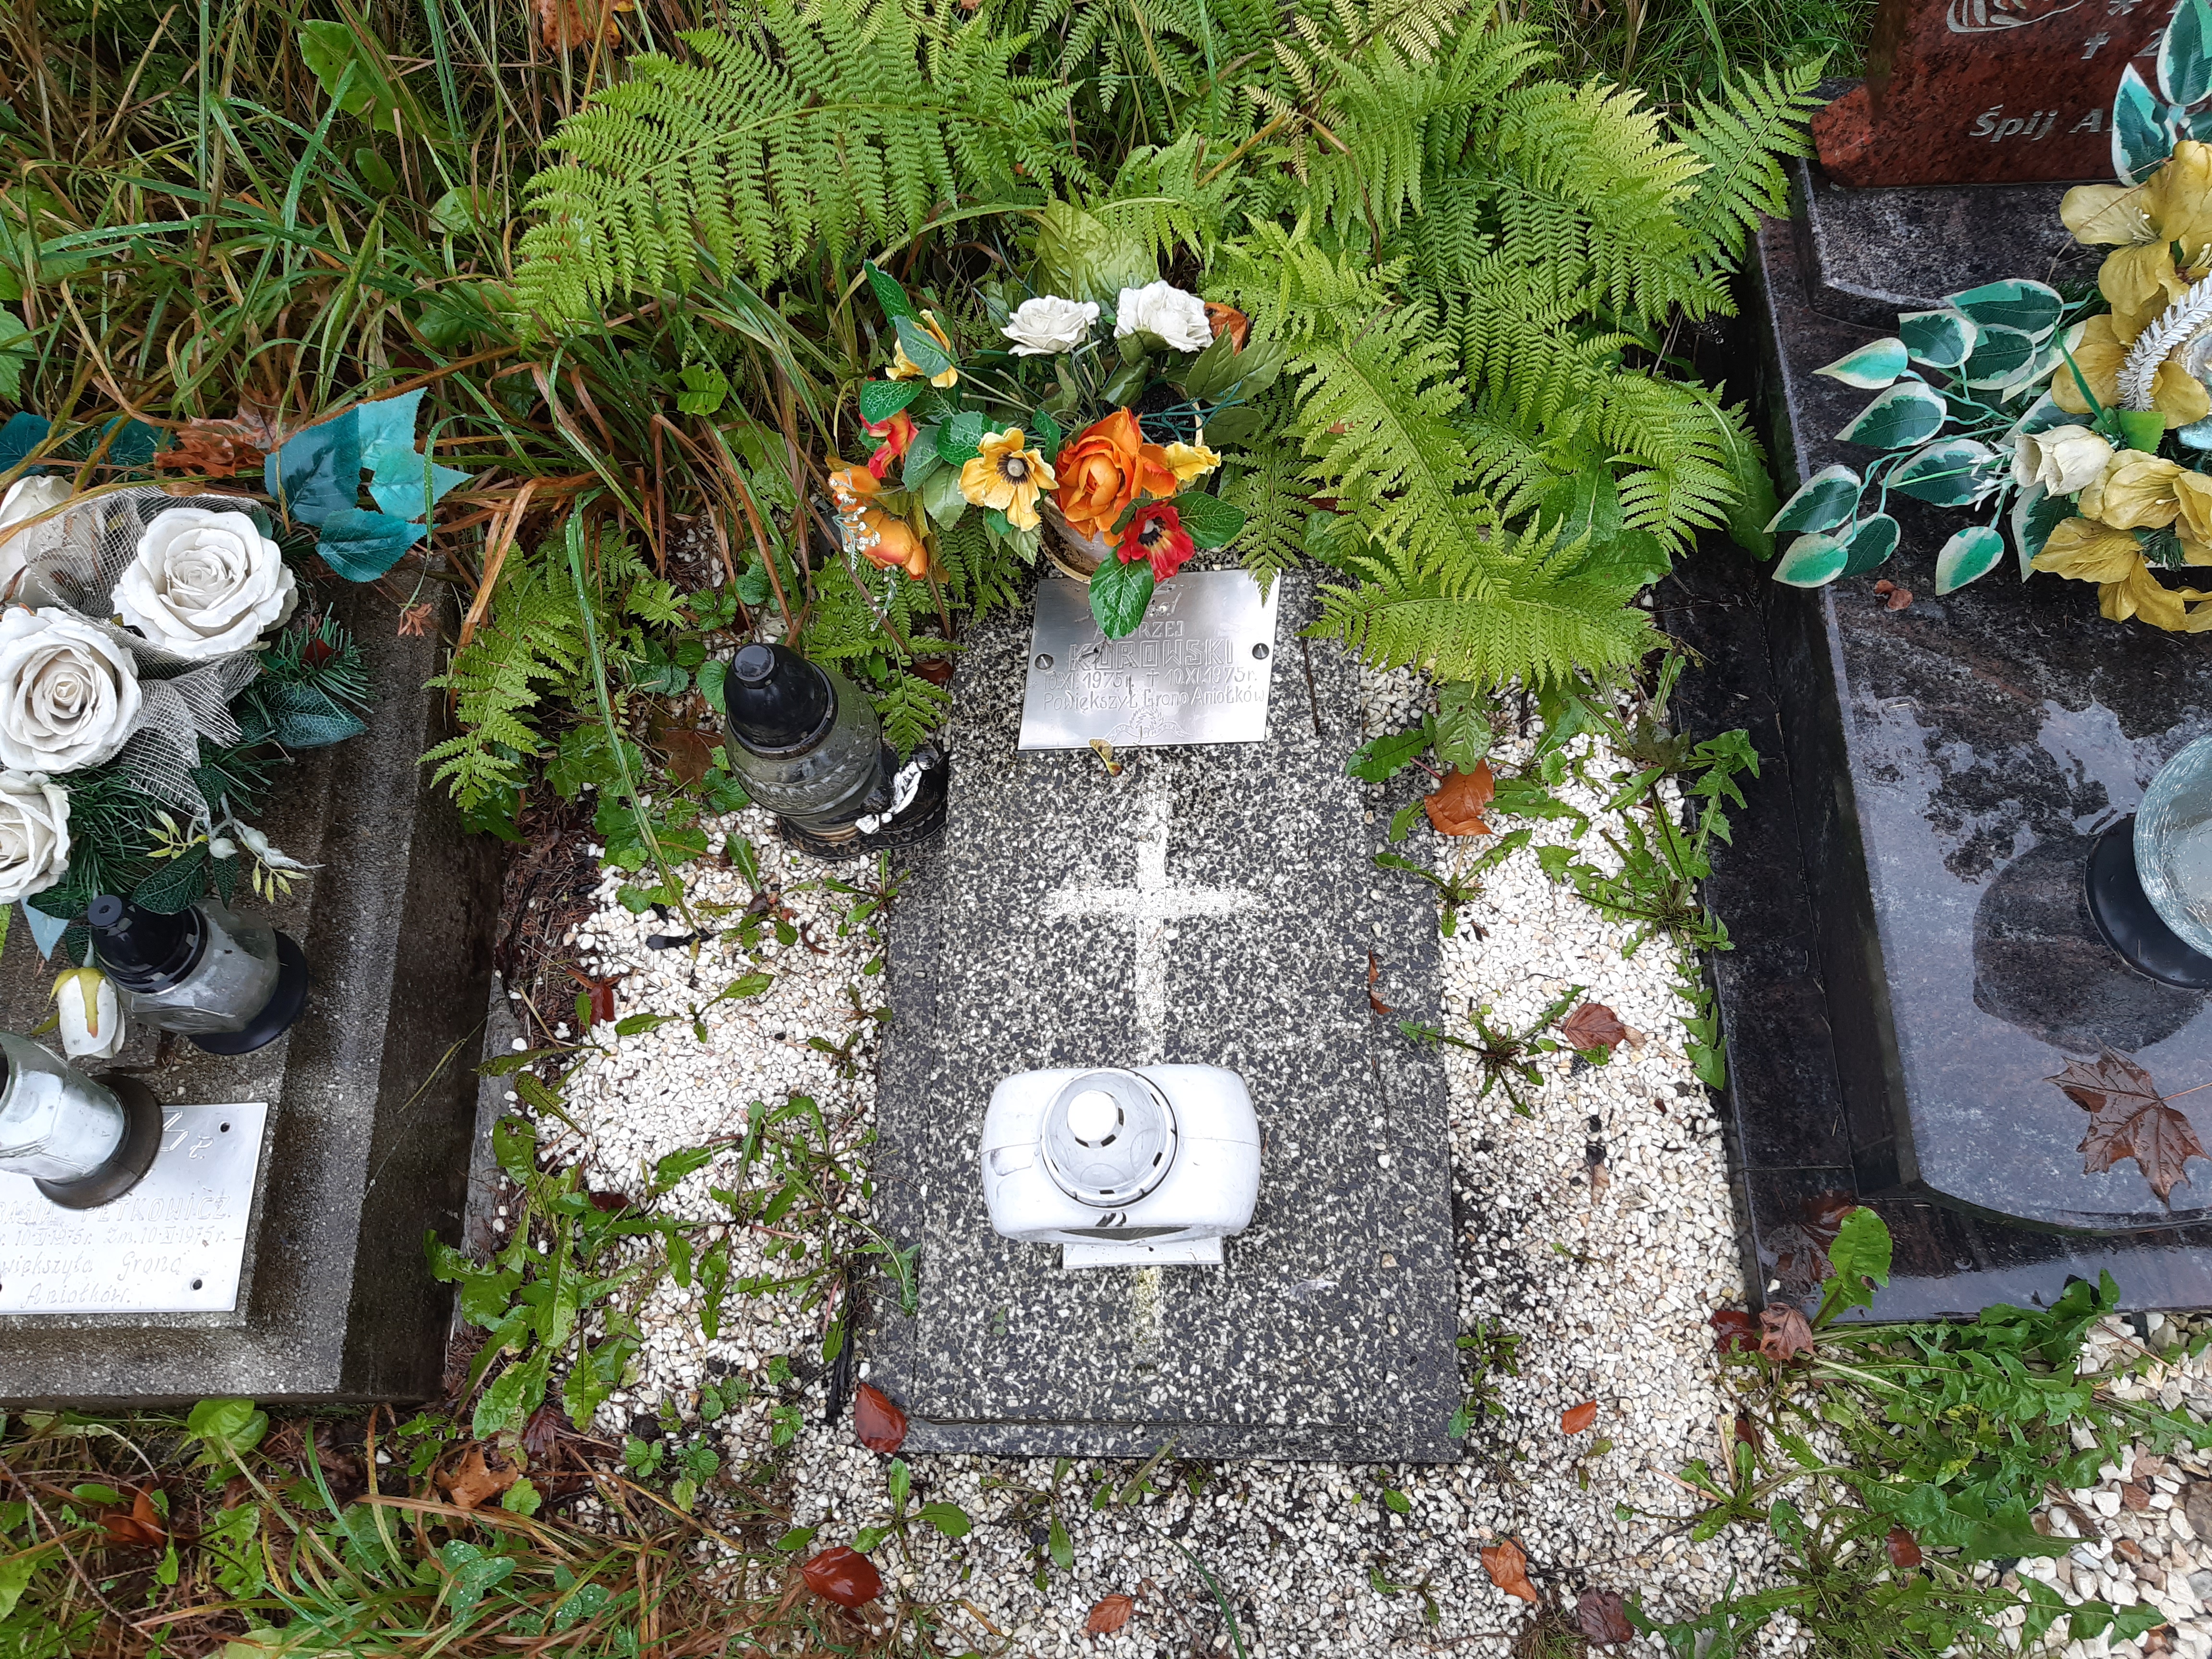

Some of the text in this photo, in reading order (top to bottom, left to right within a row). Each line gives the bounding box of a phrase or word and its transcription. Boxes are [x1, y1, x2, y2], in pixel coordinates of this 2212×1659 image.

[1969, 103, 2058, 143] Śpij
[1094, 621, 1184, 640] RZEJ
[1144, 688, 1189, 707] Grono
